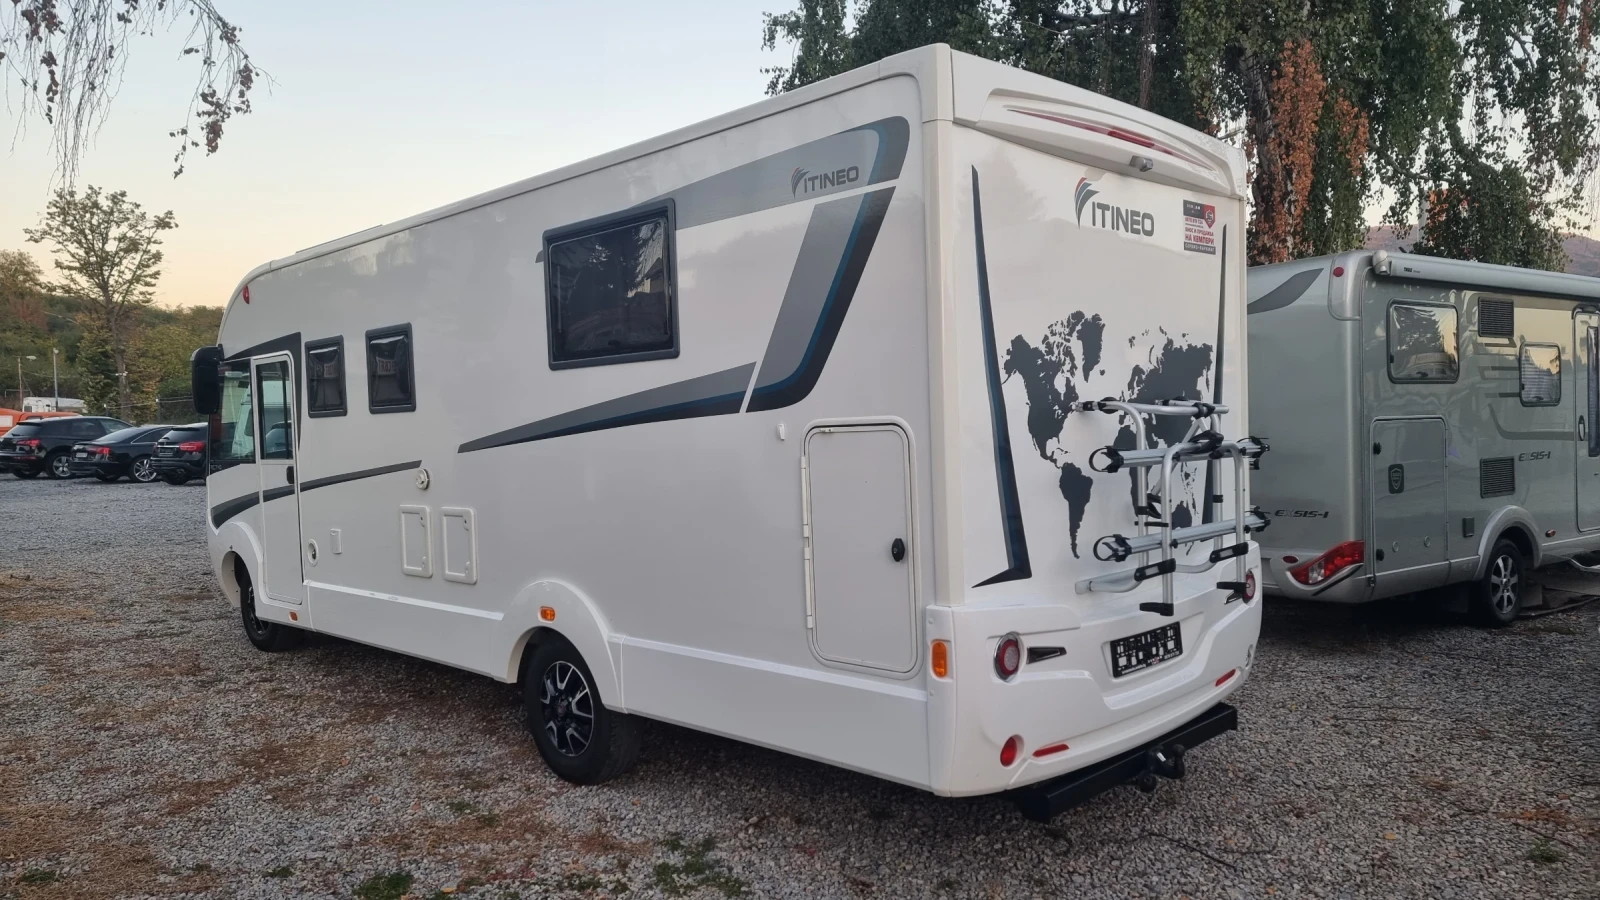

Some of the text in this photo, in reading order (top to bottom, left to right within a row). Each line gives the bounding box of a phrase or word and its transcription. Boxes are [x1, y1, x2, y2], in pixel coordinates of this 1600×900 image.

[803, 166, 859, 193] ITINEO
[1092, 201, 1154, 237] ITINEO
[1185, 233, 1215, 245] НА КЕМПЕРИ
